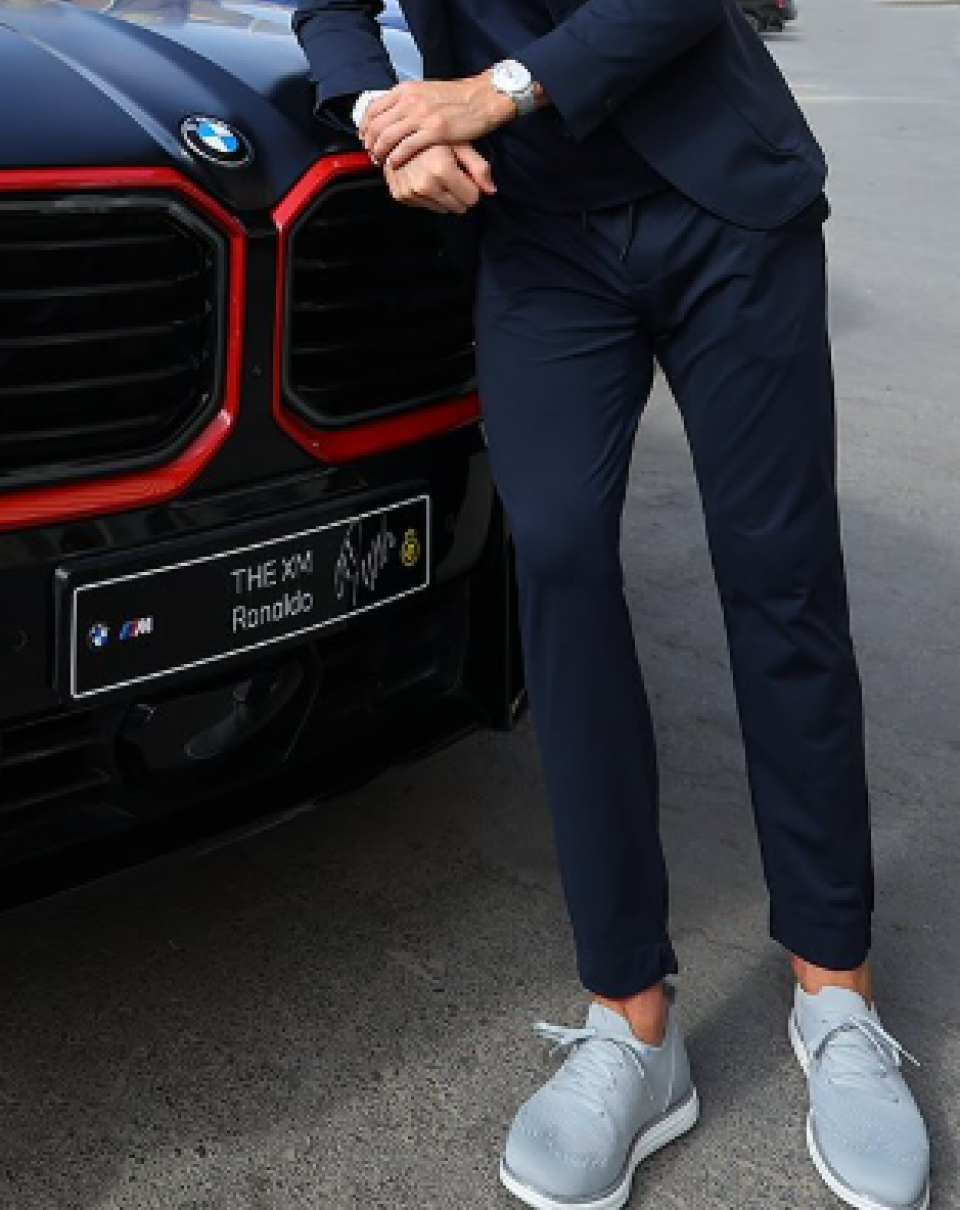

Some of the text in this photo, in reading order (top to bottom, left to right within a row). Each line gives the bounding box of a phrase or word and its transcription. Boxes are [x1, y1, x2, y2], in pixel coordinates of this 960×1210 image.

[230, 550, 313, 594] THE XM
[233, 590, 313, 634] Ronaldo
